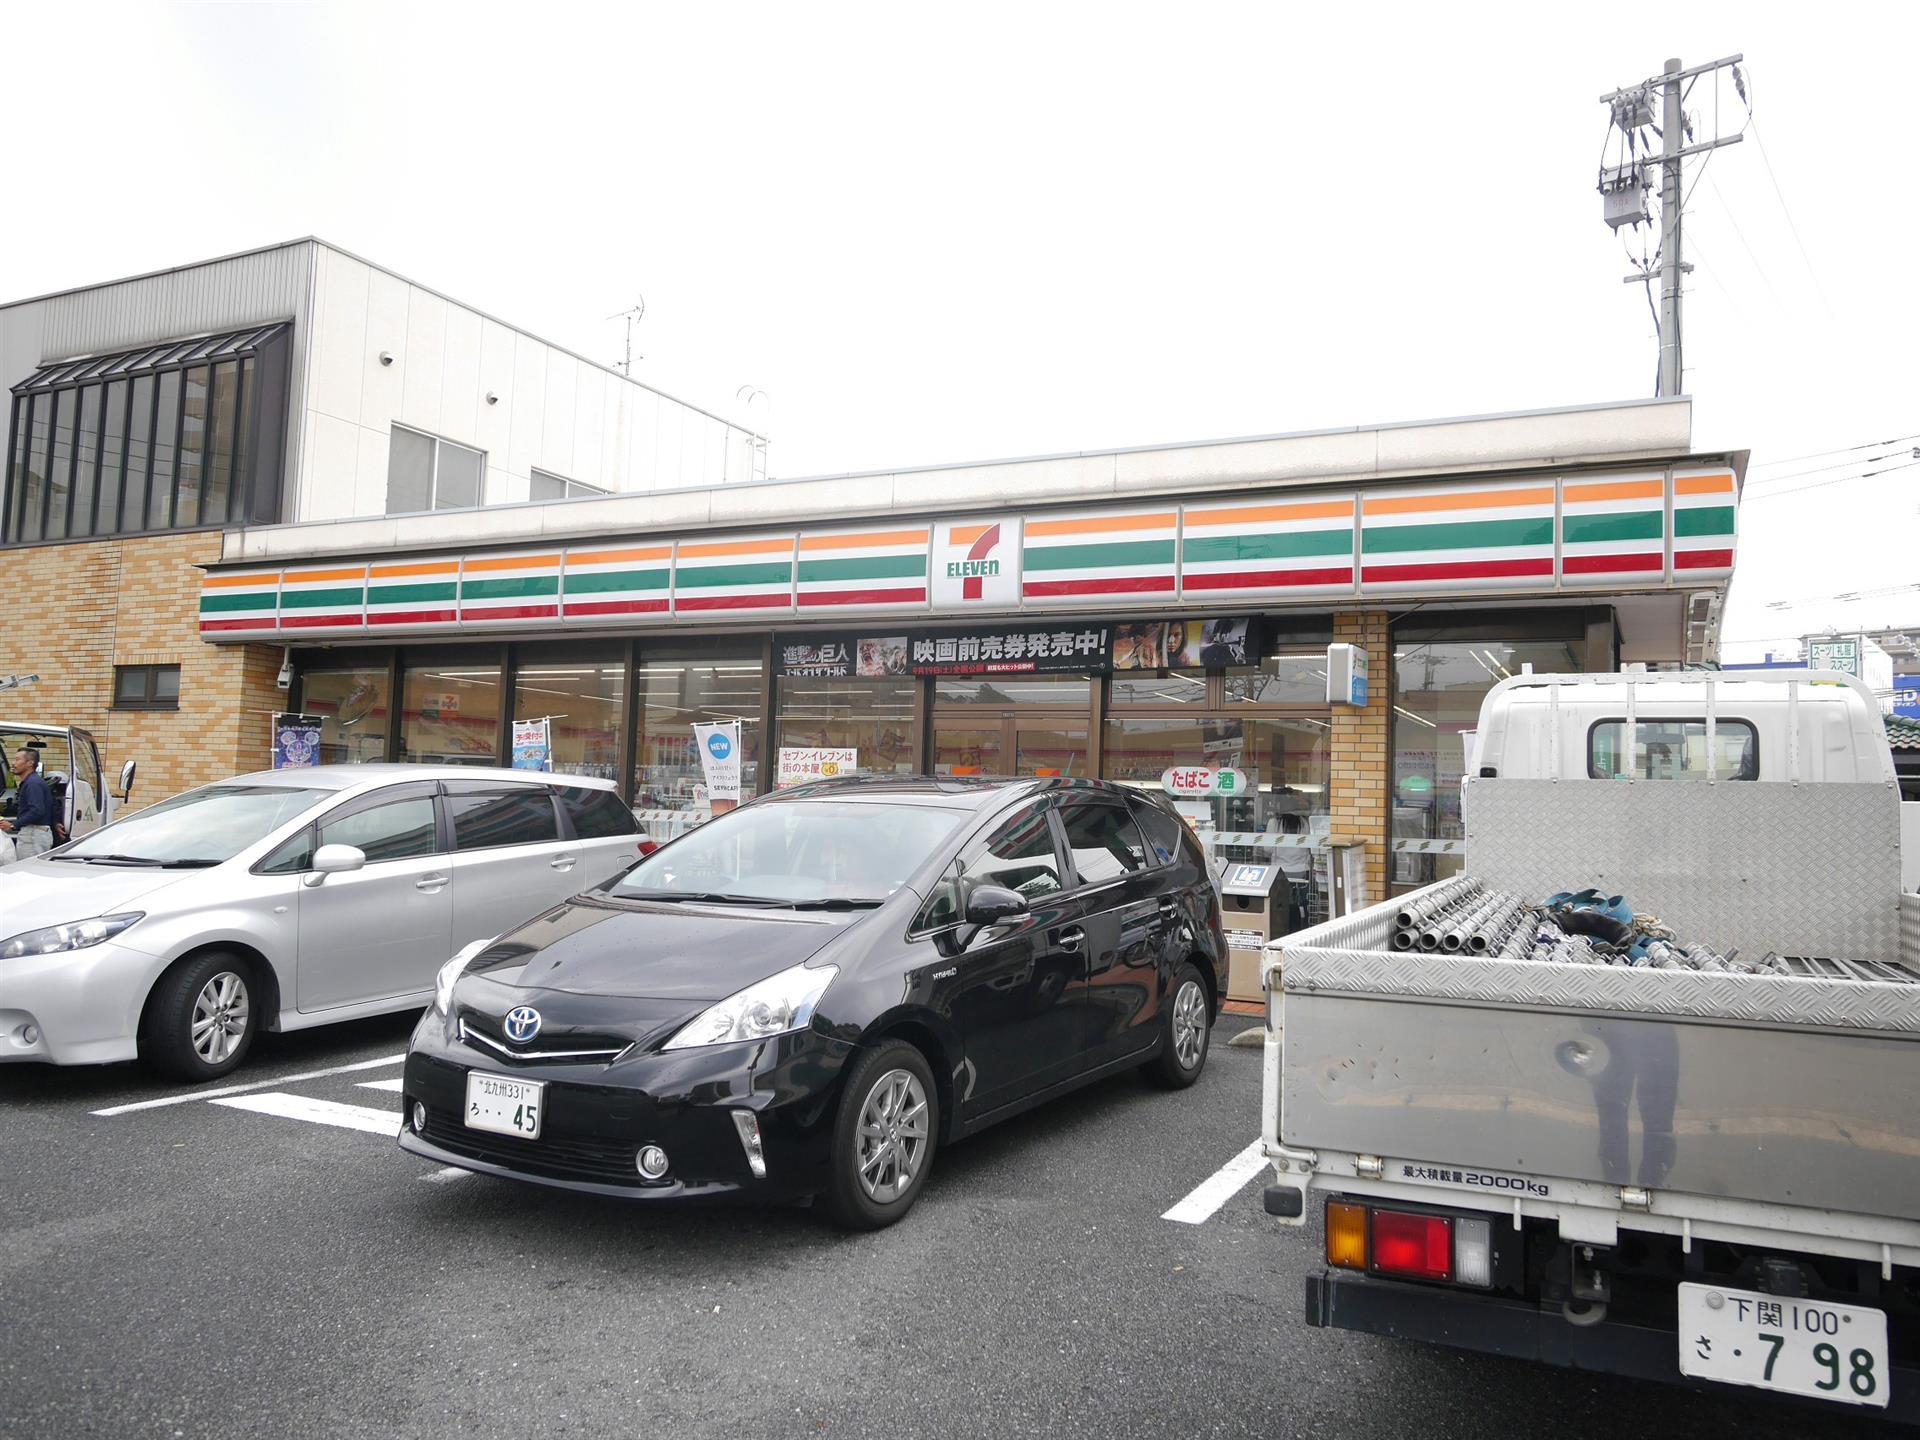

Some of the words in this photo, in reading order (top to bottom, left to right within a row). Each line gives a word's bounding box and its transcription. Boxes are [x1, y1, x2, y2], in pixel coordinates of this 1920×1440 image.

[949, 523, 1000, 599] 7
[783, 643, 850, 664] 進撃の巨人
[912, 629, 1107, 663] 映画前売券発売中!
[1814, 645, 1831, 657] スーツ
[709, 742, 729, 751] NEW
[782, 762, 820, 774] 街の本屋
[1171, 770, 1210, 789] たばこ
[1217, 771, 1235, 789] 酒
[484, 1081, 507, 1097] 北九州
[507, 1084, 523, 1100] 331
[470, 1102, 480, 1116] ろ
[513, 1103, 537, 1132] 45
[1403, 1165, 1464, 1184] 最大積載量
[1465, 1172, 1549, 1196] 2000kg
[1728, 1296, 1783, 1328] 下関
[1793, 1306, 1839, 1336] 100
[1695, 1335, 1712, 1360] さ
[1758, 1332, 1784, 1382] 7
[1812, 1342, 1876, 1397] 98
